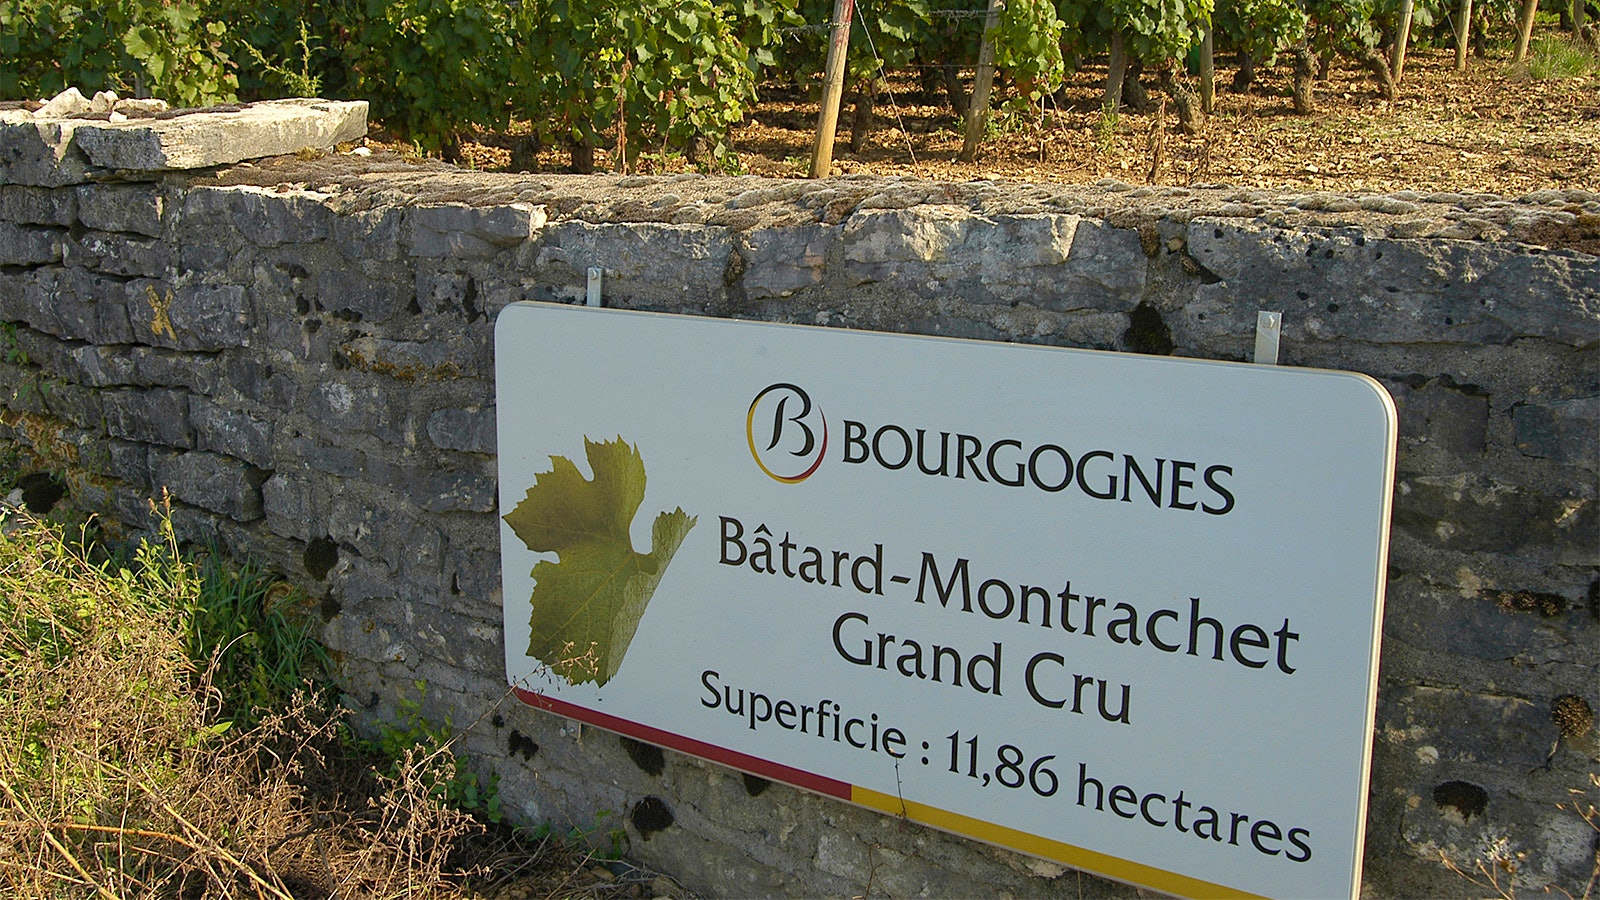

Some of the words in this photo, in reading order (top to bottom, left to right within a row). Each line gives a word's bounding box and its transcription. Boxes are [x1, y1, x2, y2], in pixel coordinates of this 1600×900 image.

[842, 419, 1235, 516] BOURGOGNES
[718, 515, 1300, 675] Bâtard-Montrachet
[832, 612, 1003, 697] Grand
[1024, 651, 1132, 726] Cru
[700, 669, 907, 759] Superficie
[920, 740, 931, 767] :
[946, 729, 1059, 799] 11,86
[1076, 762, 1312, 864] hectares
